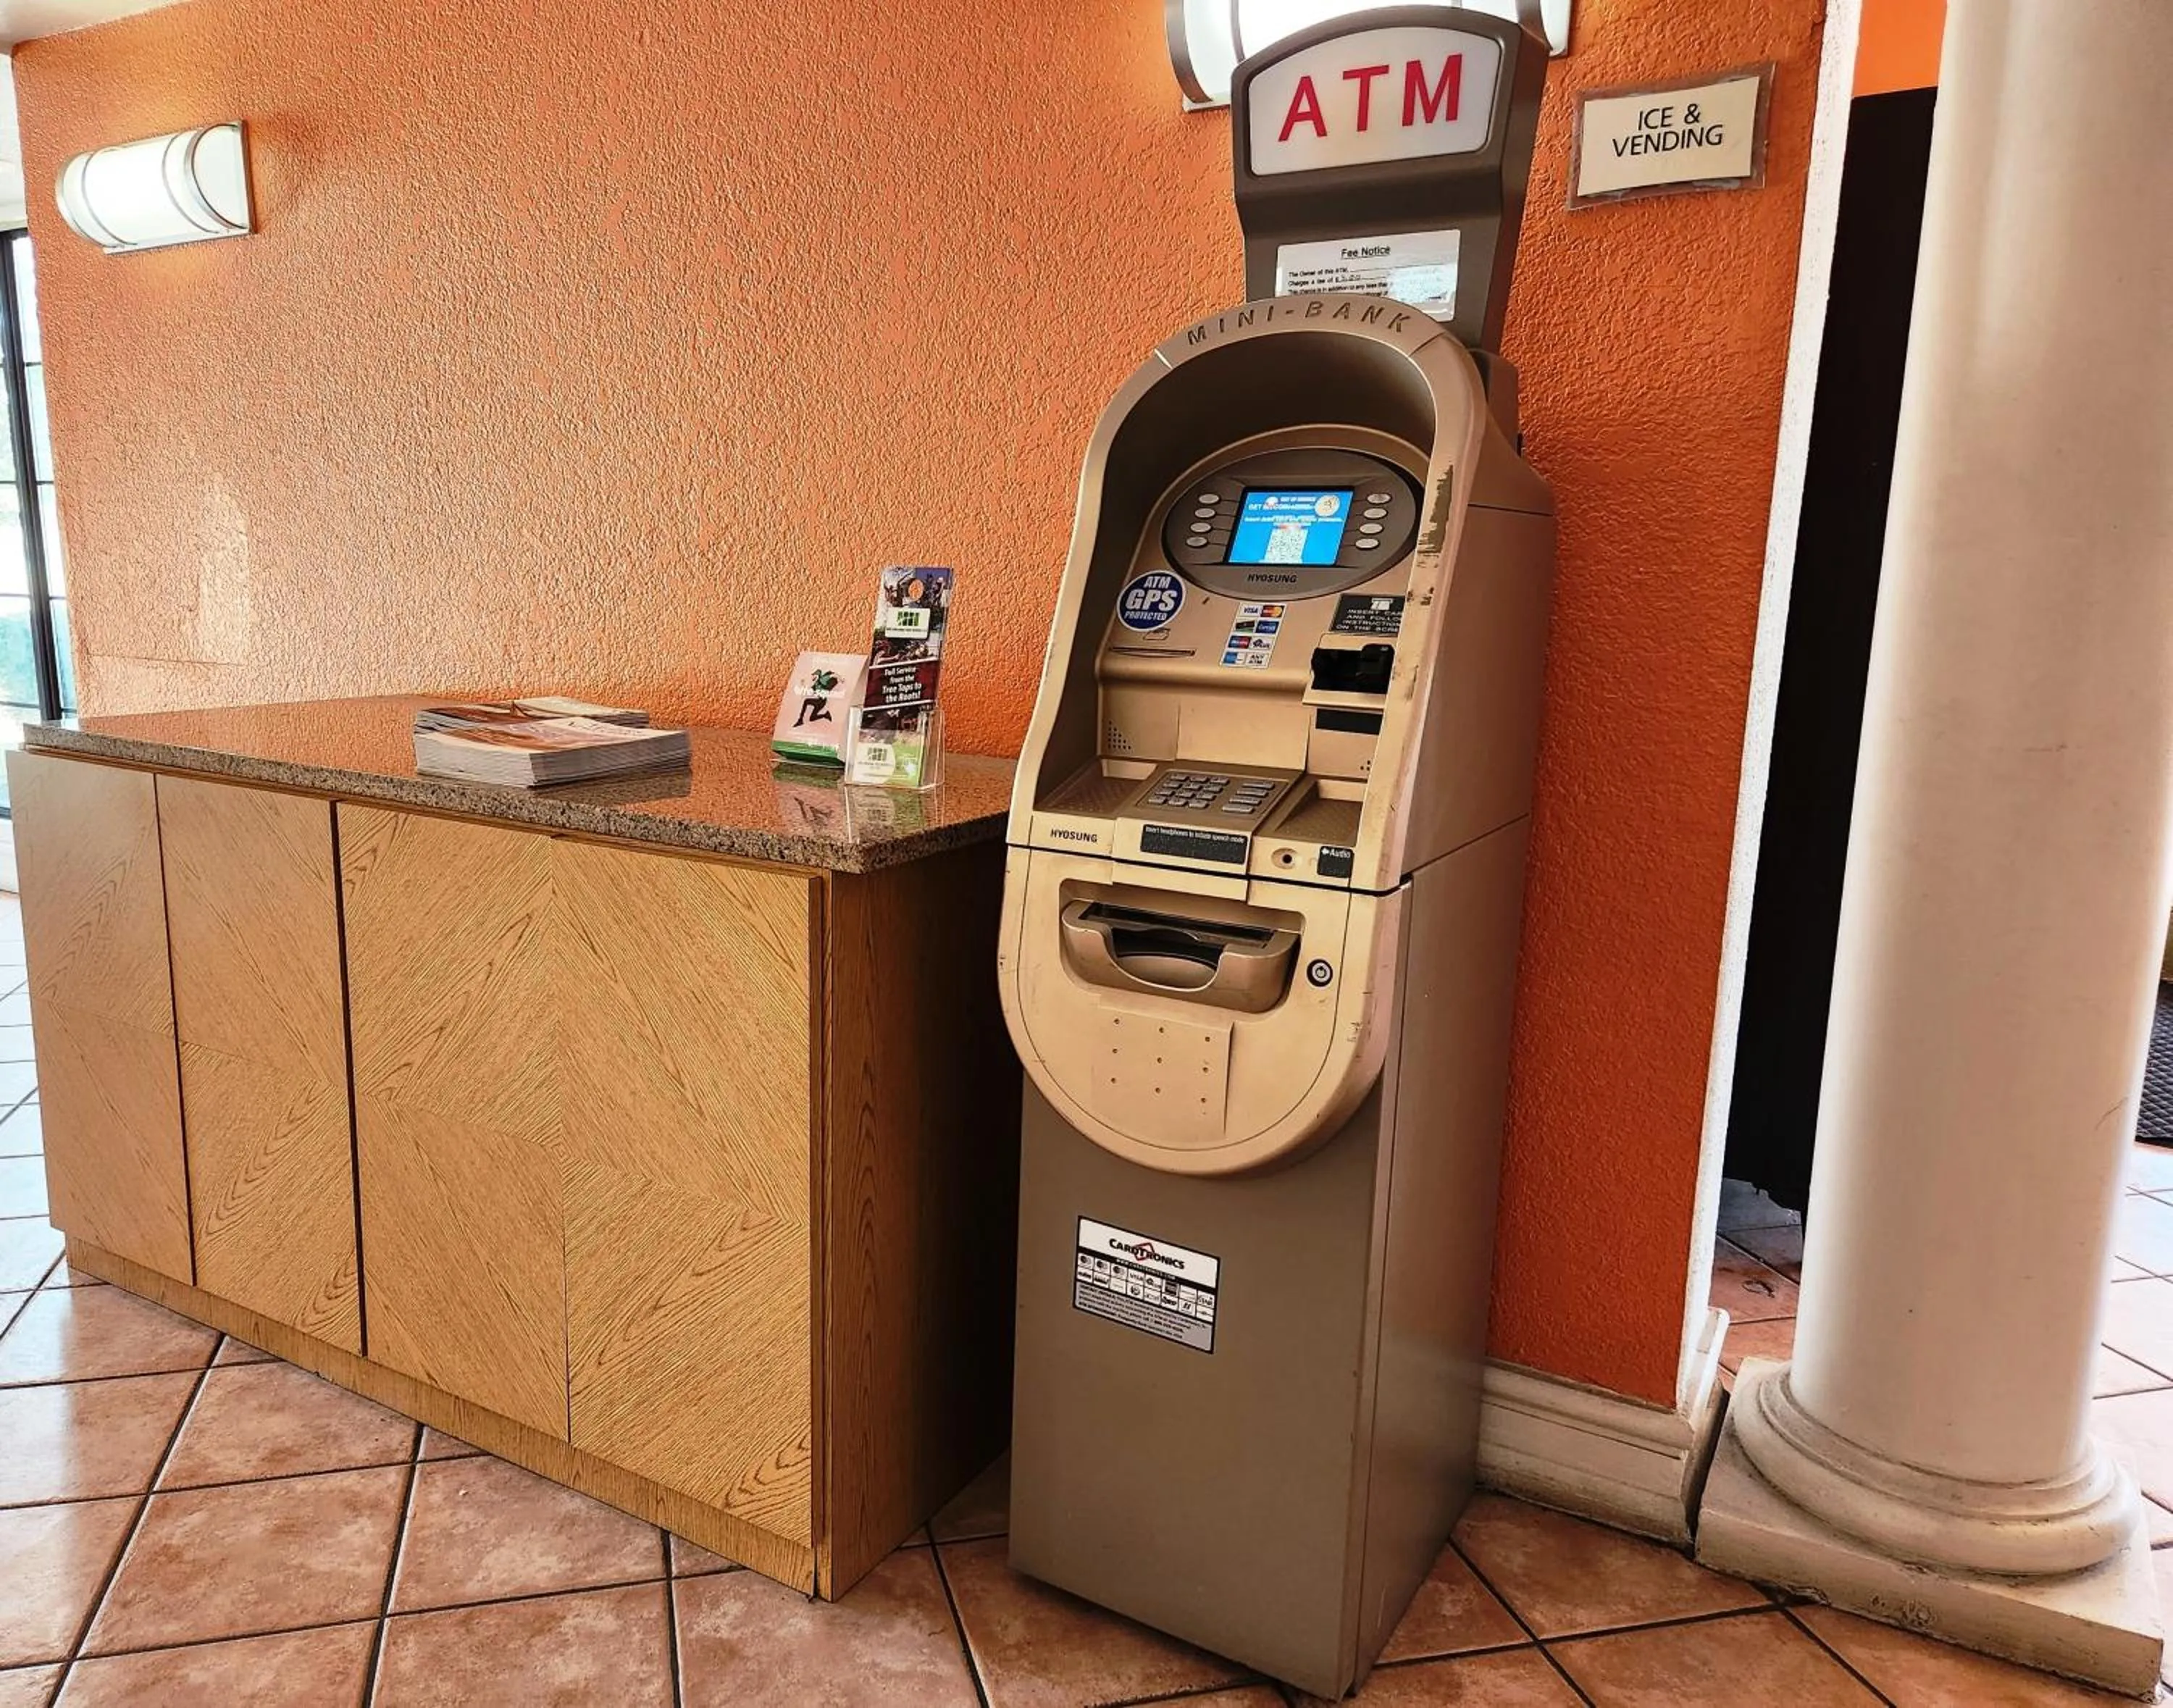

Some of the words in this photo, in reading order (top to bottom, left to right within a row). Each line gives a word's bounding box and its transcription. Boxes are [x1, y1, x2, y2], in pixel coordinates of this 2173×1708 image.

[1278, 54, 1462, 142] ATM
[1638, 106, 1674, 130] ICE
[1684, 104, 1701, 124] &
[1612, 125, 1723, 157] VENDING
[1341, 248, 1358, 257] Fee
[1361, 246, 1391, 256] Notice
[1187, 301, 1410, 346] MINI-BANK
[1144, 576, 1172, 589] ATM
[1247, 573, 1297, 583] HYOSUNG
[1125, 588, 1178, 612] GPS
[1124, 611, 1167, 621] PROTECTED
[882, 685, 897, 694] Tree
[1050, 829, 1097, 842] HYOSUNG
[1330, 848, 1351, 858] Audio
[1108, 1238, 1185, 1270] CARDTRONICS
